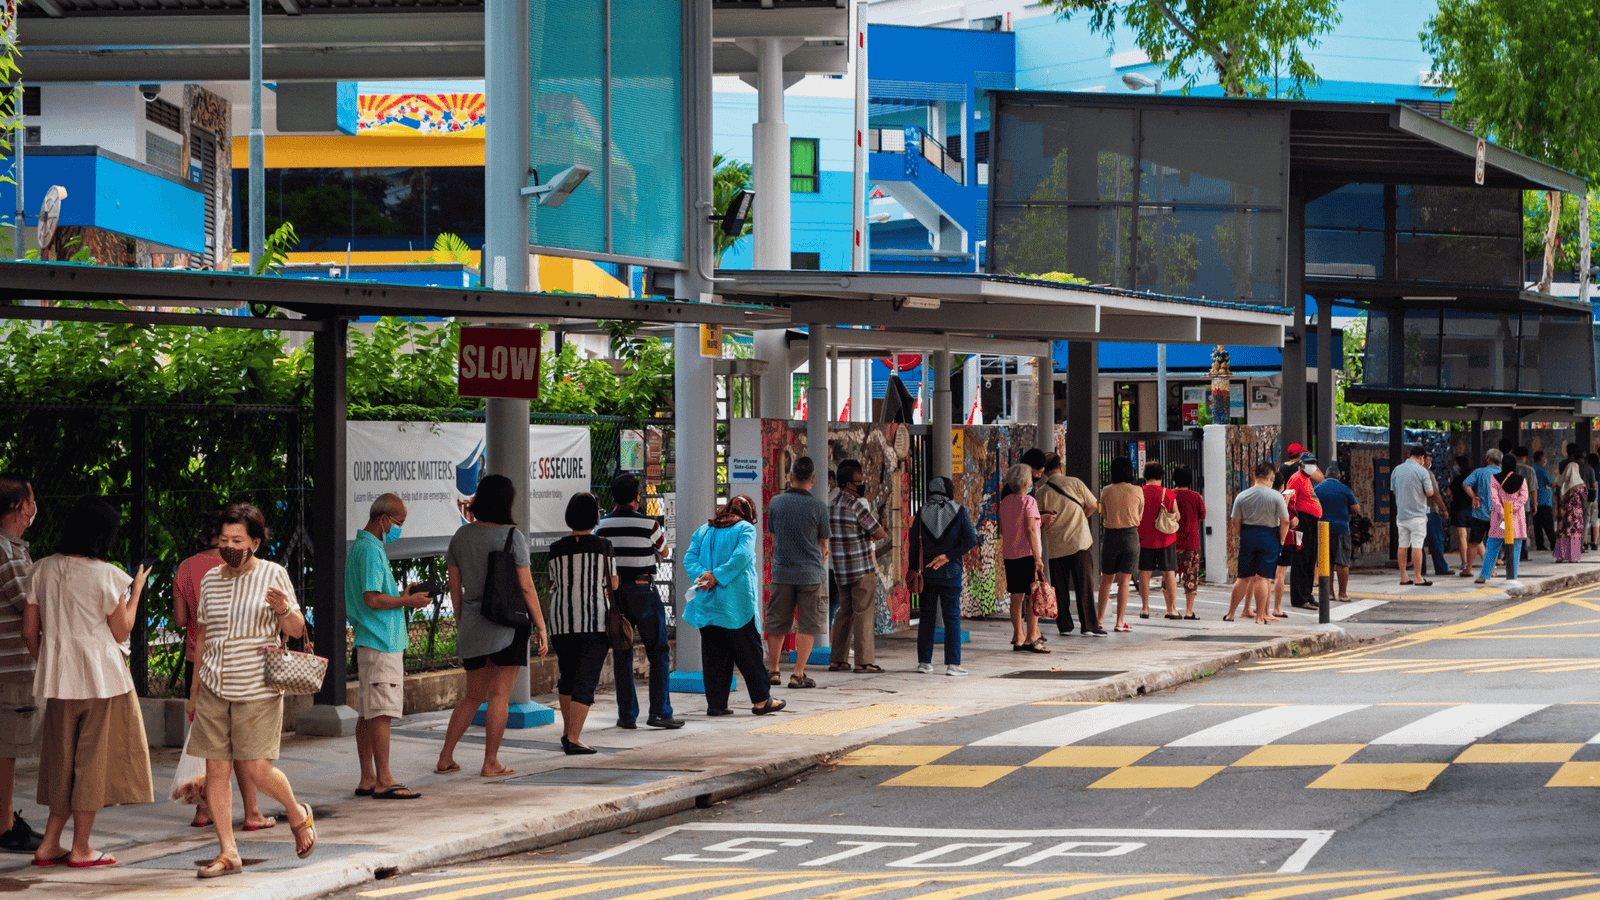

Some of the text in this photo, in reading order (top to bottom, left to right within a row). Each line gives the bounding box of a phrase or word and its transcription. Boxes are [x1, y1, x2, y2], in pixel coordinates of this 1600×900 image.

[462, 345, 537, 380] SLOW
[354, 461, 455, 481] OUR RESPONSE MATTERS.
[539, 457, 586, 479] SGSECURE.
[661, 838, 1147, 867] STOP
